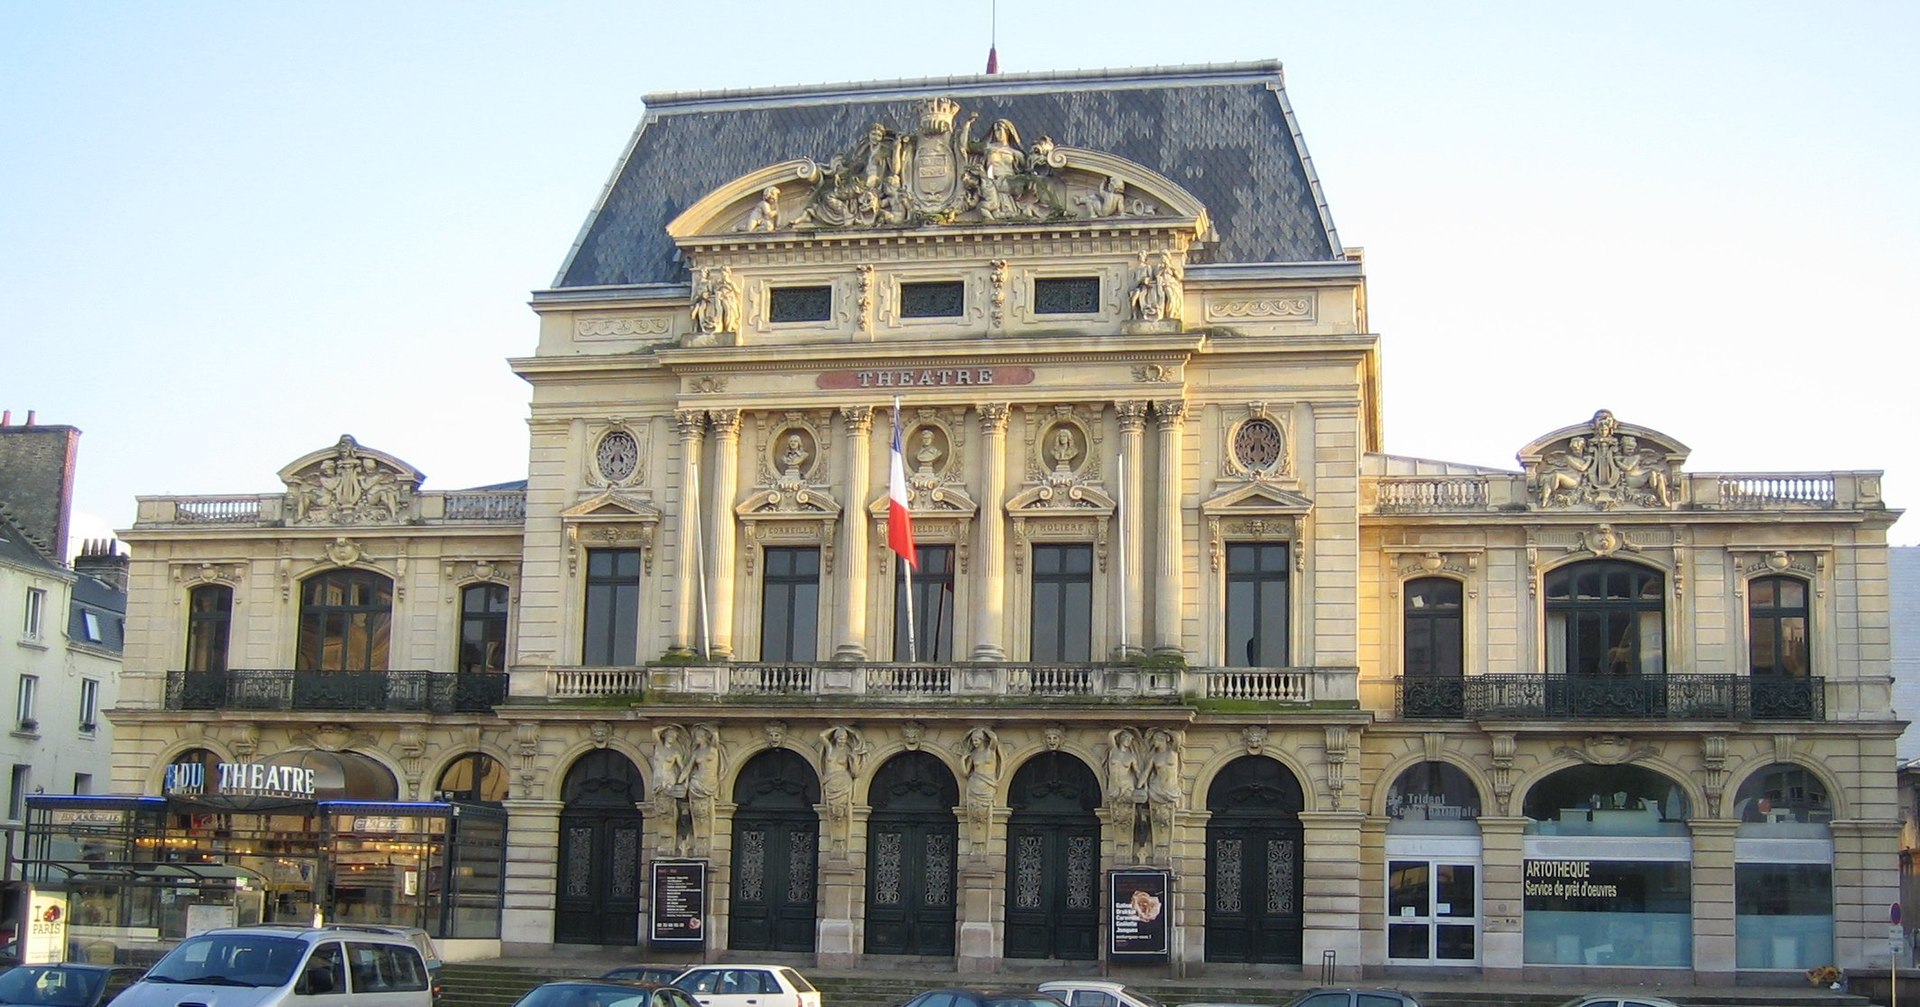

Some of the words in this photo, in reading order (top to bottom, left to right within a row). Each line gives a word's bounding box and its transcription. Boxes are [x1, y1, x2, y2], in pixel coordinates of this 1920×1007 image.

[857, 368, 994, 387] THEATRE
[181, 763, 203, 788] DU
[219, 763, 315, 794] THEATRE
[1407, 792, 1446, 804] Trident
[1526, 861, 1590, 878] ARTOTHEQUE
[1525, 880, 1553, 896] Service
[1554, 880, 1564, 896] de
[1581, 881, 1617, 897] d'oeuvres
[34, 905, 41, 922] I
[33, 923, 61, 935] PARIS
